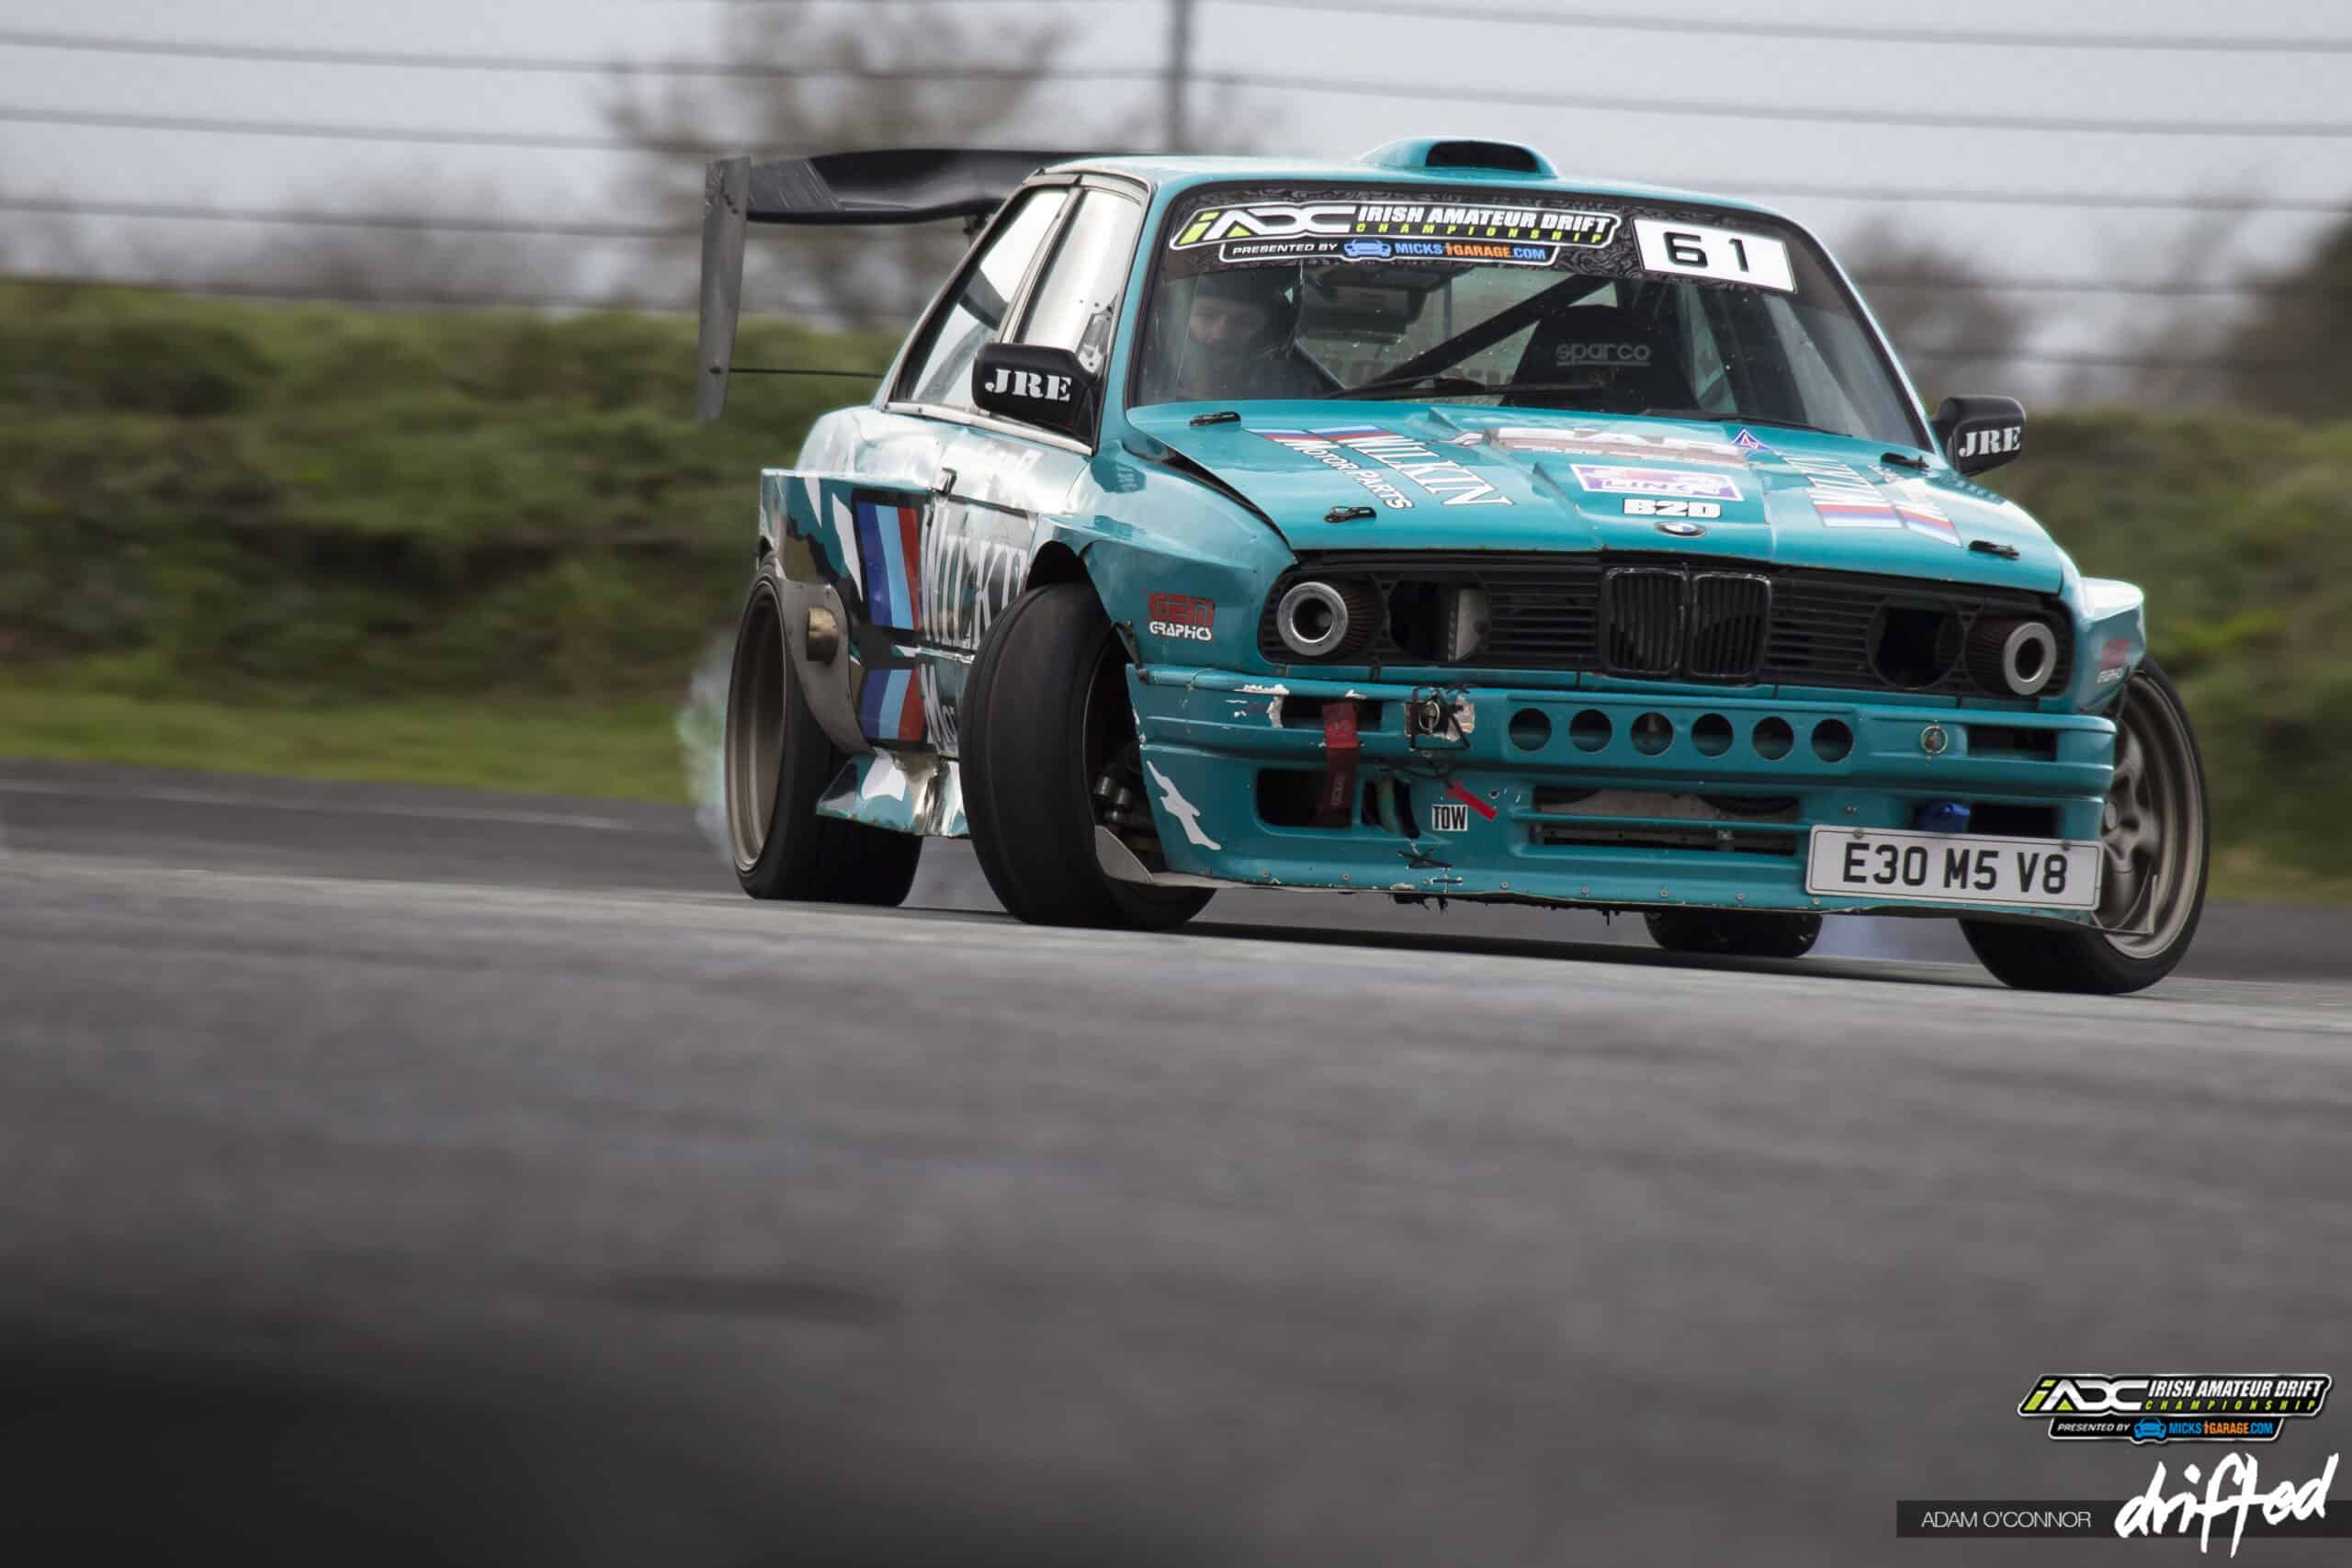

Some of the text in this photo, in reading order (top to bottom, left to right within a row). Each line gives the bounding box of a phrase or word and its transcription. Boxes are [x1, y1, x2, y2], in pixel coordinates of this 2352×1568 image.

[1355, 223, 1605, 243] CHAMPIONSHIP
[1358, 206, 1423, 223] IRISH
[1427, 208, 1537, 228] AMATEUR
[1540, 213, 1611, 233] DRIFT
[1232, 243, 1338, 255] PRESENTED BY
[1663, 231, 1749, 273] 61
[1555, 343, 1652, 364] sparco
[984, 367, 1072, 402] JRE
[1958, 425, 2021, 457] JRE
[1432, 805, 1467, 830] TOW
[1842, 842, 2070, 896] E30 M5 V8
